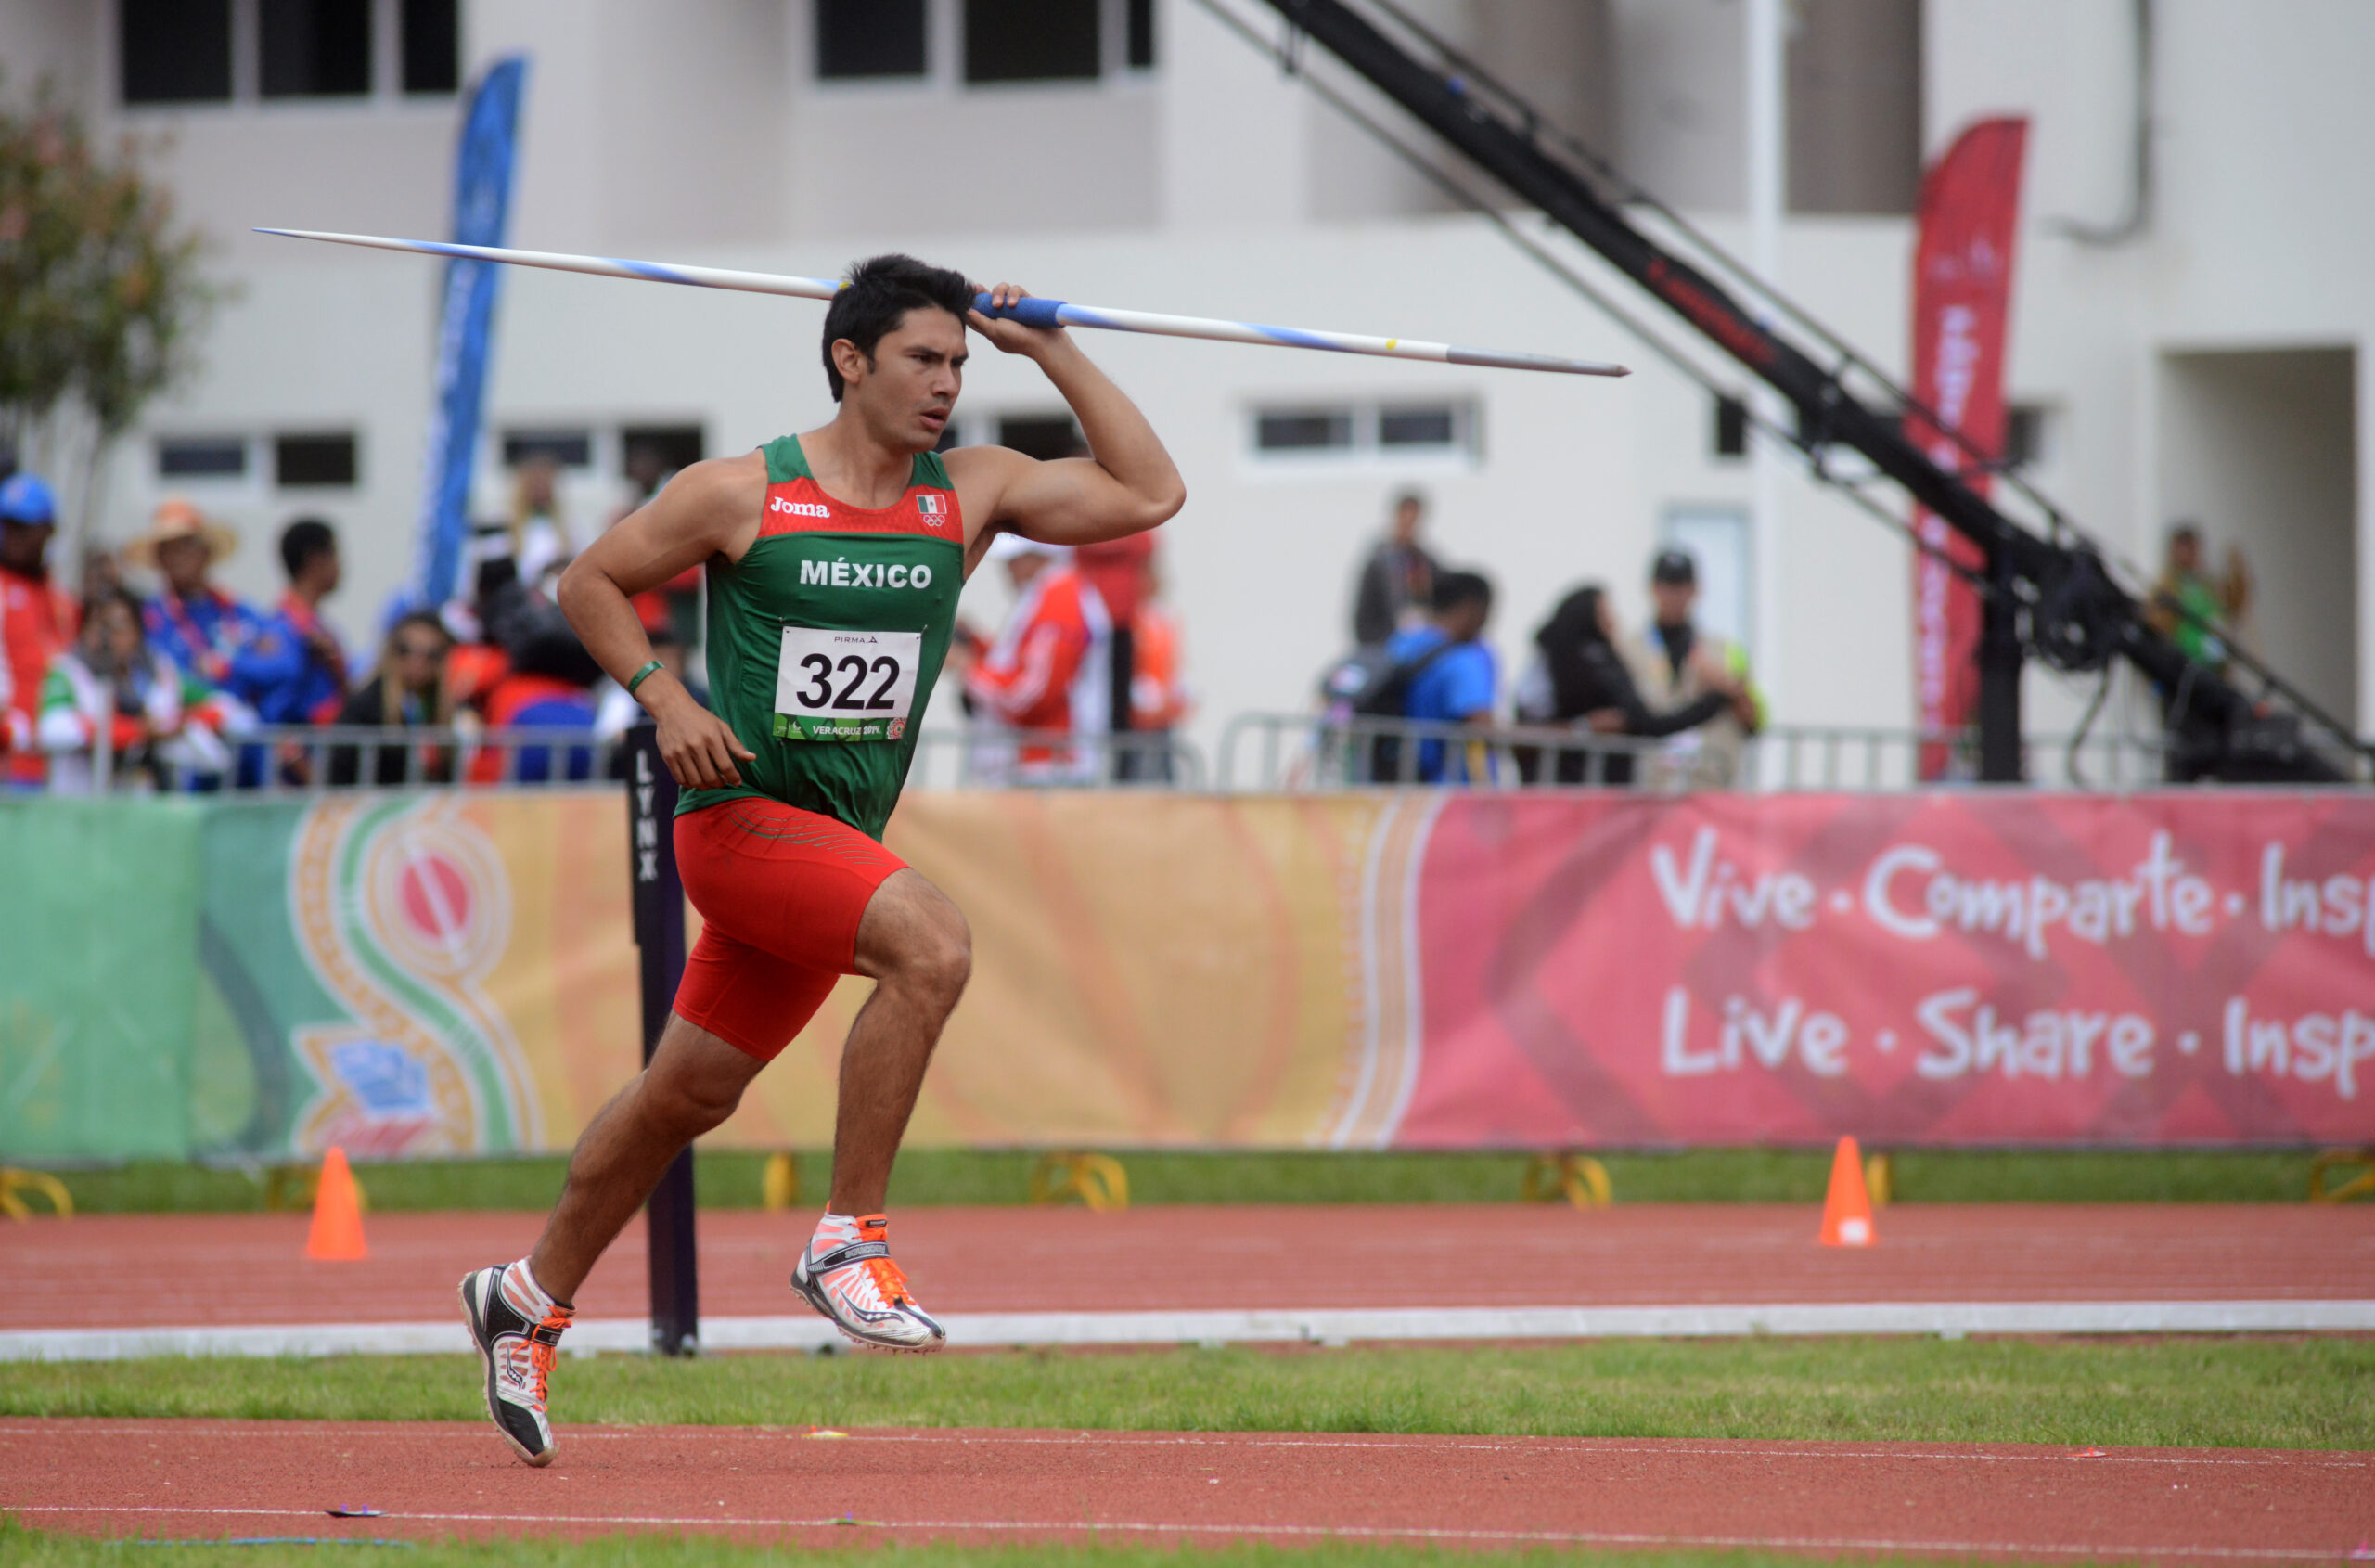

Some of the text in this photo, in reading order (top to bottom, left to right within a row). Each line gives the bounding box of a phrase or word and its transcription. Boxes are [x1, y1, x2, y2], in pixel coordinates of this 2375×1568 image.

[770, 496, 830, 519] Joma
[800, 557, 931, 589] MÉXICO
[796, 653, 900, 710] 322
[813, 726, 861, 736] VERACRUZ
[636, 749, 658, 881] LYNX
[1650, 825, 1816, 929] Vive
[1863, 829, 2213, 961] Comparte
[1662, 985, 1848, 1077] Live
[1915, 986, 2155, 1081] Share
